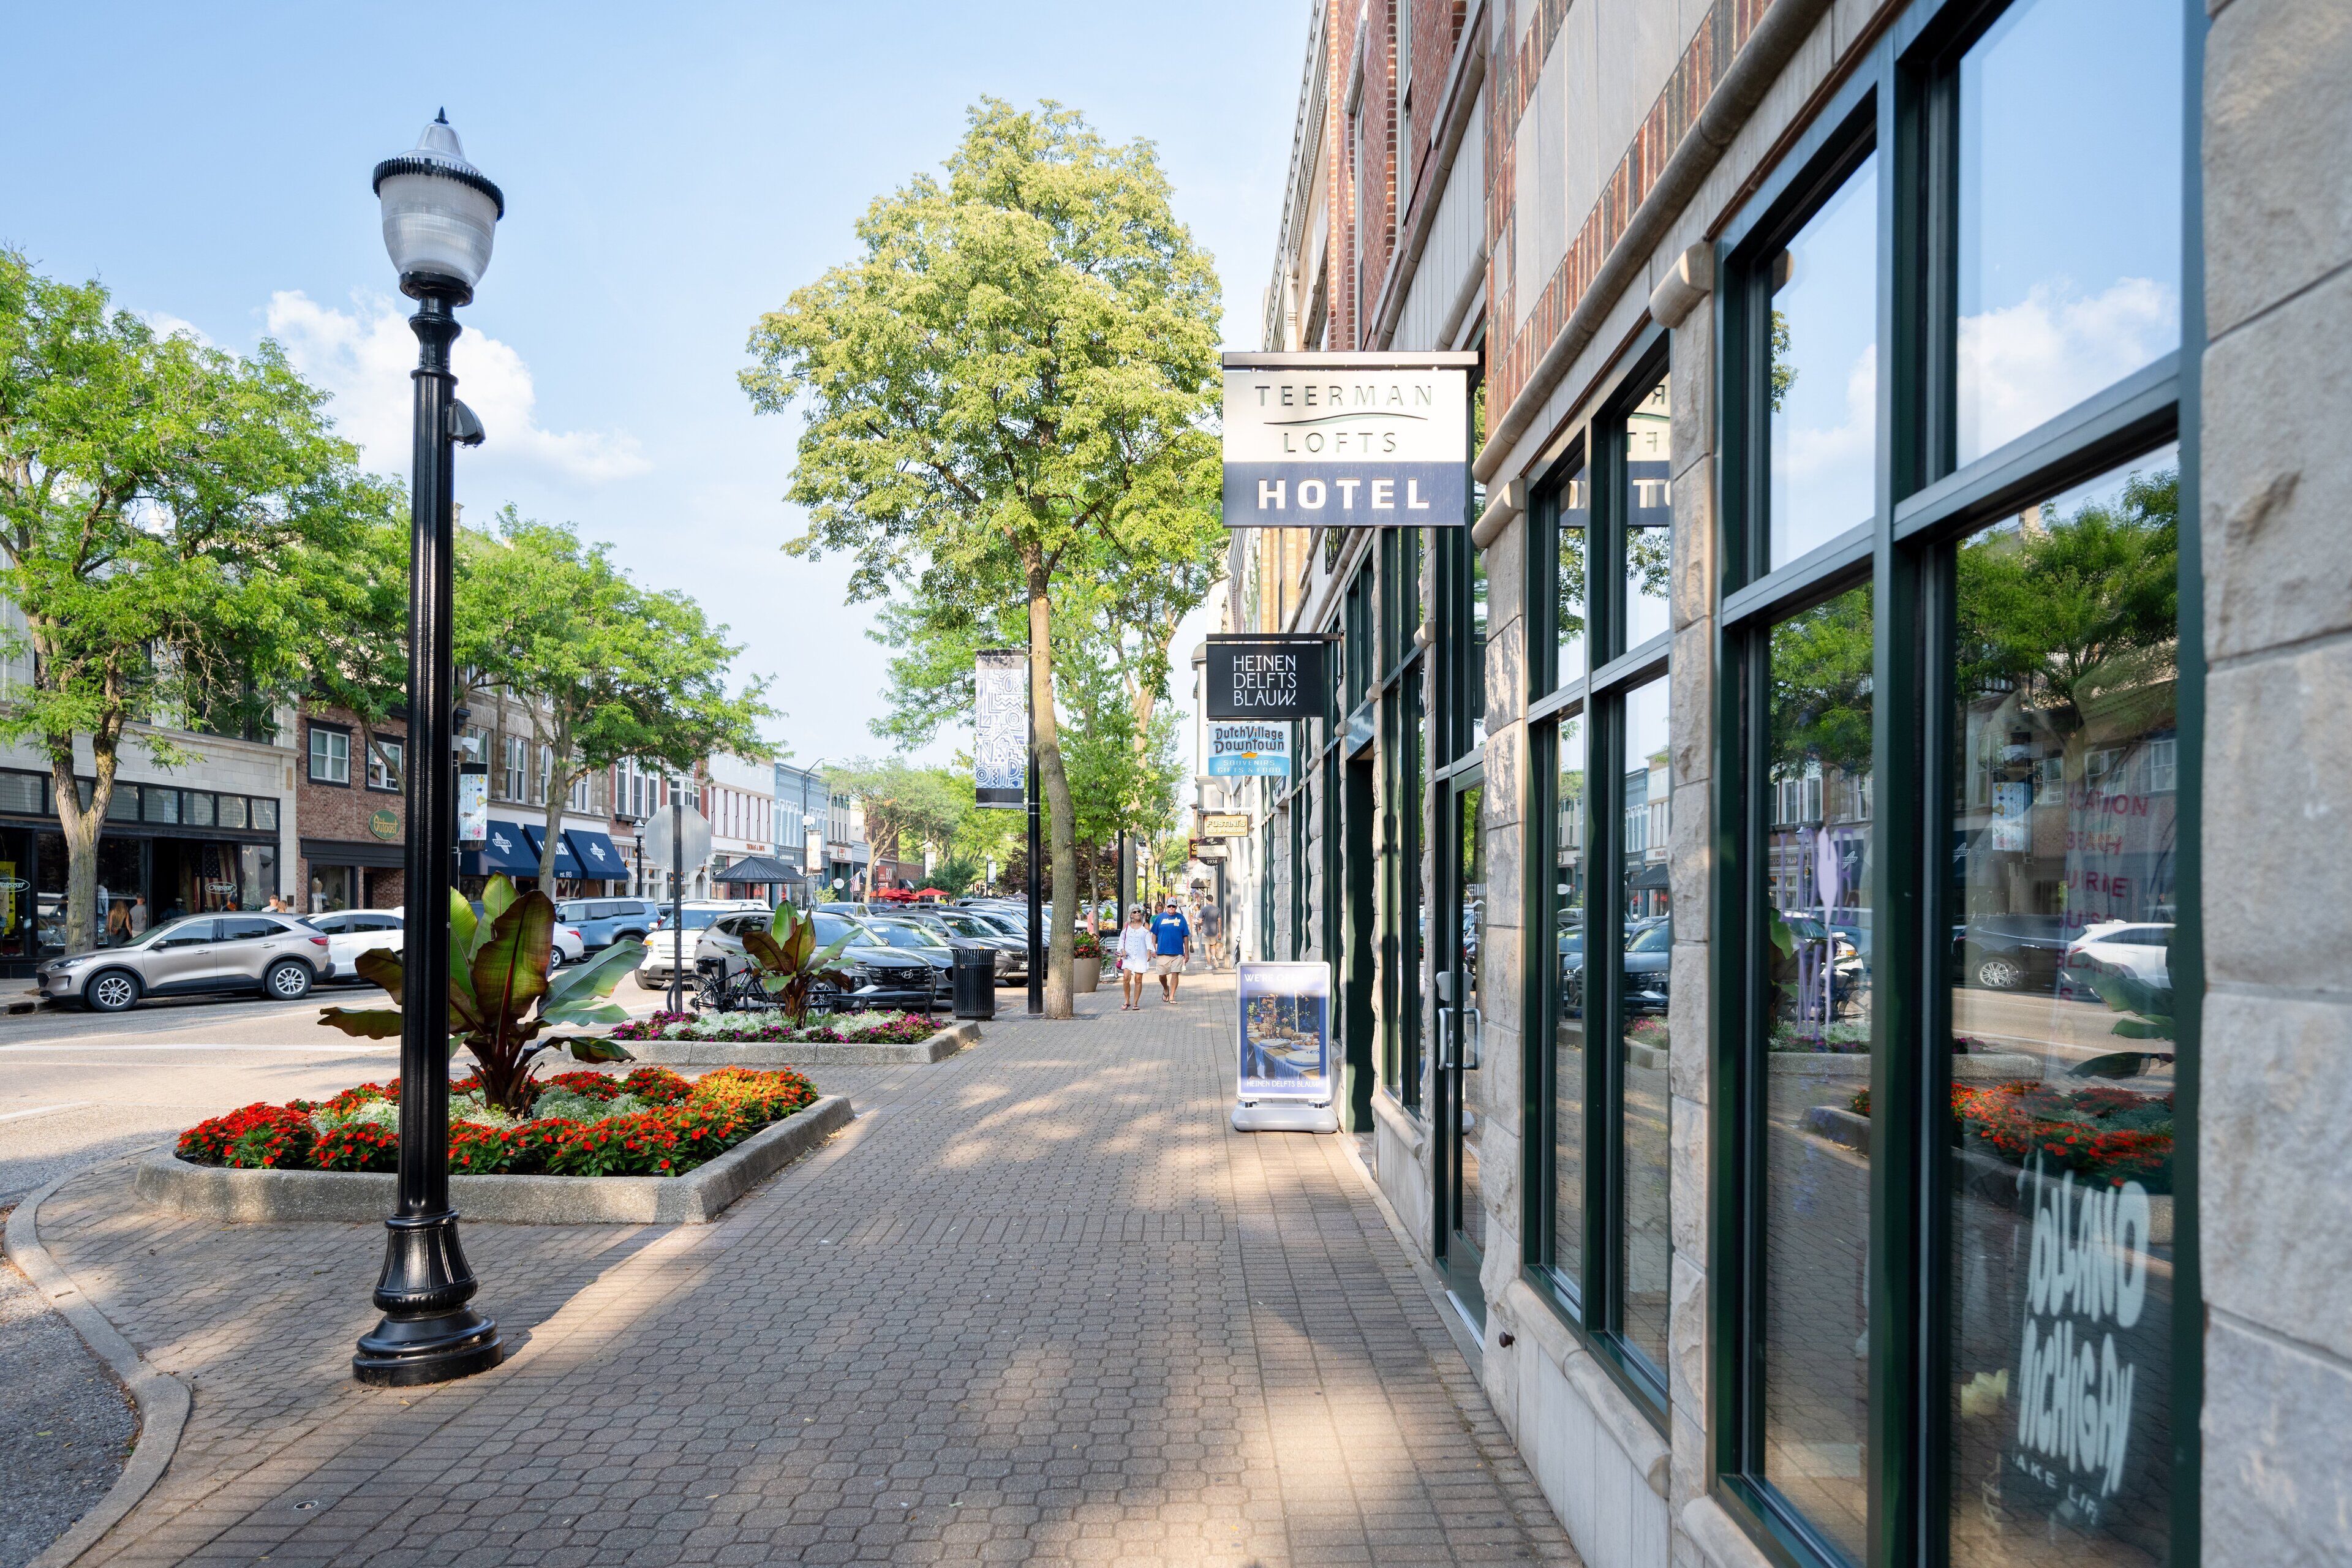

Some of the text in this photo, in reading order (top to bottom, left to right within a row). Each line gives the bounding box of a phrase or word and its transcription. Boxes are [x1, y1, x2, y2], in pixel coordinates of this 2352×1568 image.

[1254, 385, 1431, 407] TEERMAN
[1284, 432, 1396, 453] LOFTS
[1257, 478, 1430, 510] HOTEL
[1234, 655, 1296, 671] HEINEN
[1234, 672, 1297, 688] DELFTS
[1213, 738, 1284, 754] Downtown
[374, 815, 398, 836] Outpost
[1466, 883, 1486, 896] TEERMAN
[1244, 974, 1273, 982] WE'RE
[2011, 1452, 2058, 1490] AKE
